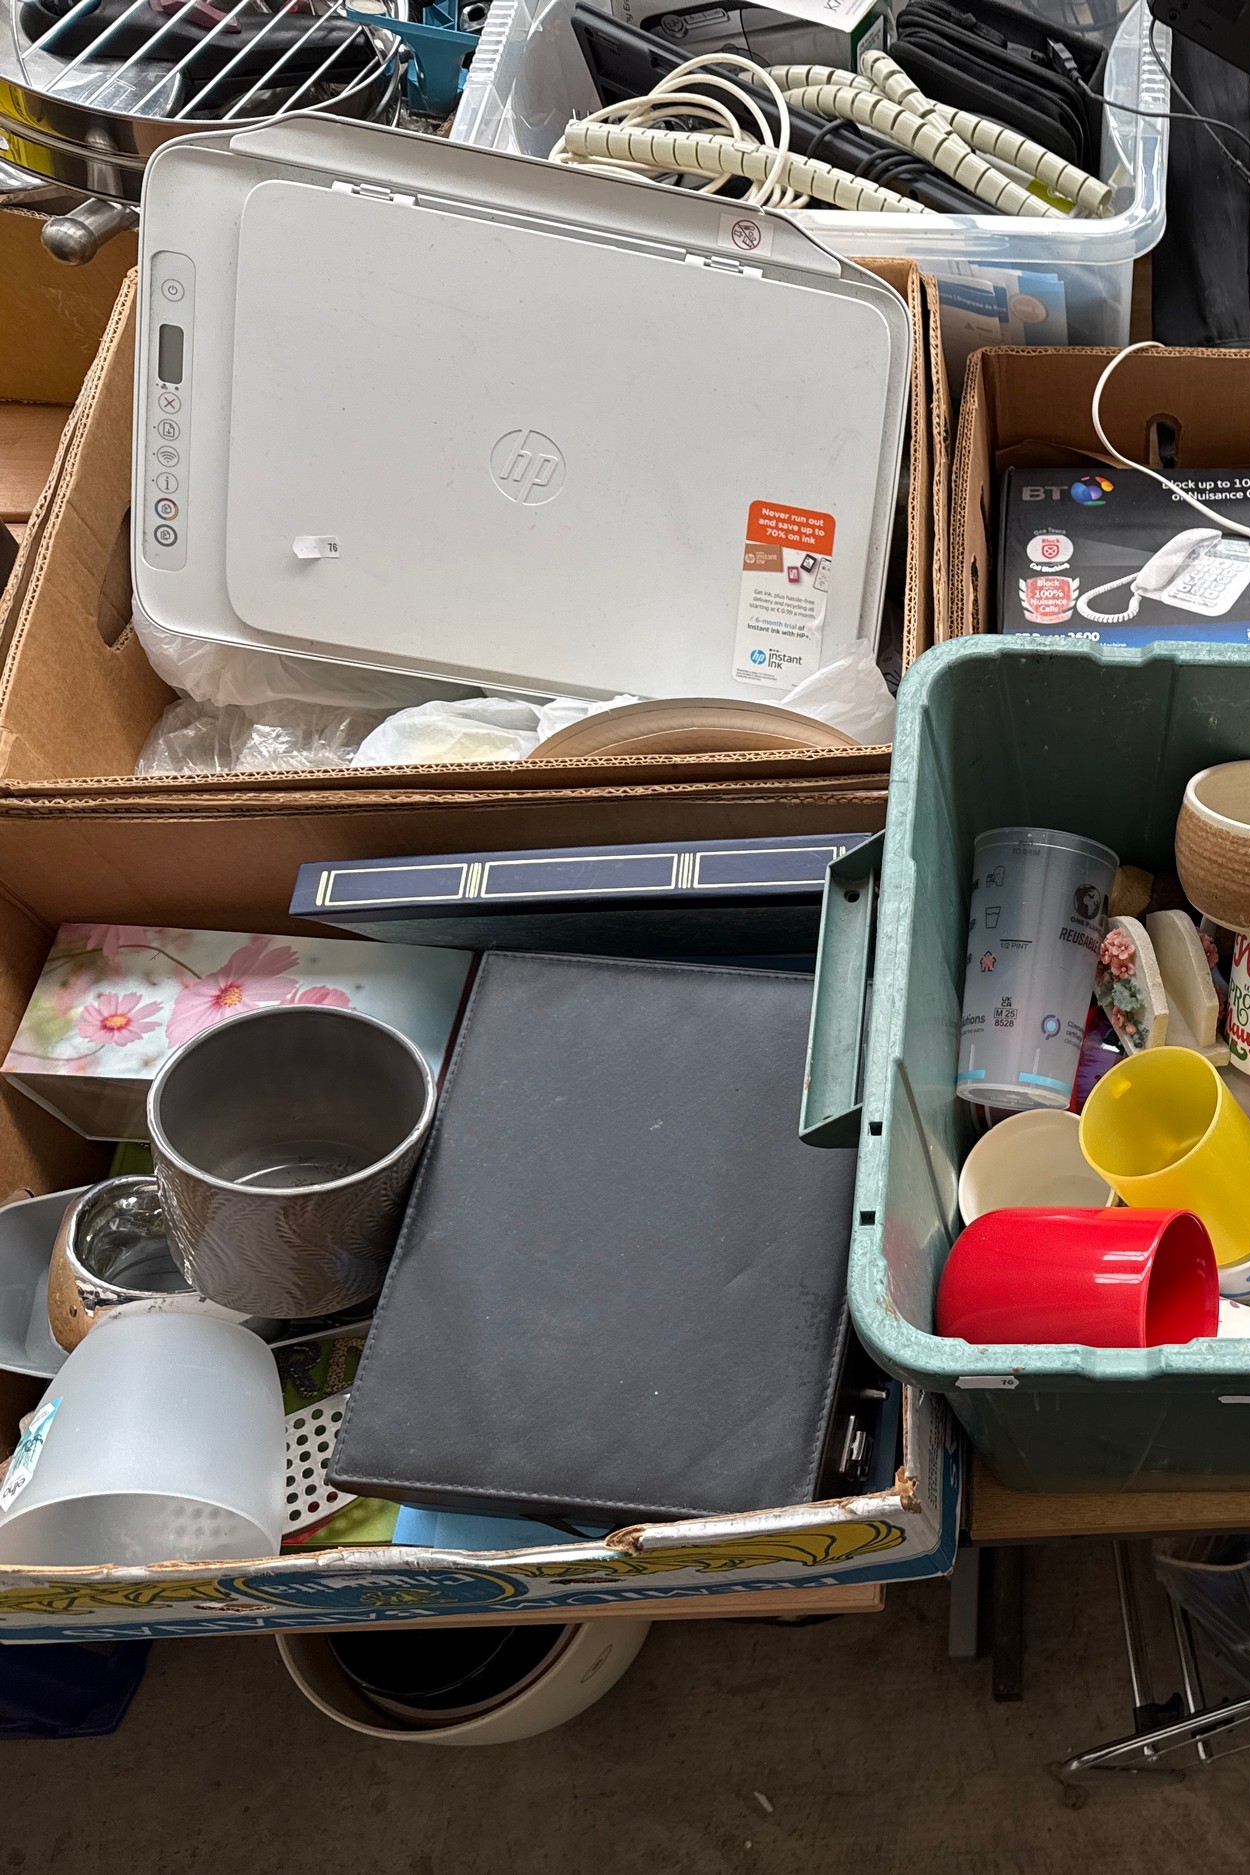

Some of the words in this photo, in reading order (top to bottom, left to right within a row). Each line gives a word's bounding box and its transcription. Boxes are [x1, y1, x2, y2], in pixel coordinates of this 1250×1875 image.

[499, 429, 558, 503] hp
[1198, 480, 1214, 490] up
[1217, 480, 1230, 488] to
[1022, 485, 1068, 501] BT
[1188, 490, 1244, 501] Nuisance
[762, 508, 790, 520] Never
[791, 514, 807, 523] run
[808, 517, 824, 527] out
[758, 518, 776, 527] and
[778, 521, 799, 532] save
[800, 526, 813, 535] up
[814, 528, 825, 537] to
[766, 528, 786, 539] 70%
[787, 534, 800, 542] on
[801, 533, 816, 545] ink
[327, 542, 338, 553] 76
[1037, 579, 1060, 587] Block
[1034, 589, 1064, 598] 100%
[1030, 598, 1068, 606] Nuisance
[1040, 605, 1059, 613] Calls
[747, 623, 770, 633] Instant
[781, 629, 796, 637] with
[755, 617, 783, 628] 6-month
[784, 622, 797, 630] trial
[750, 649, 767, 665] hp
[995, 1009, 1003, 1017] M
[1004, 1009, 1016, 1018] 25
[994, 1019, 1014, 1028] 8528
[488, 1576, 839, 1611] PREMIUM
[60, 1608, 436, 1639] BANANAS
